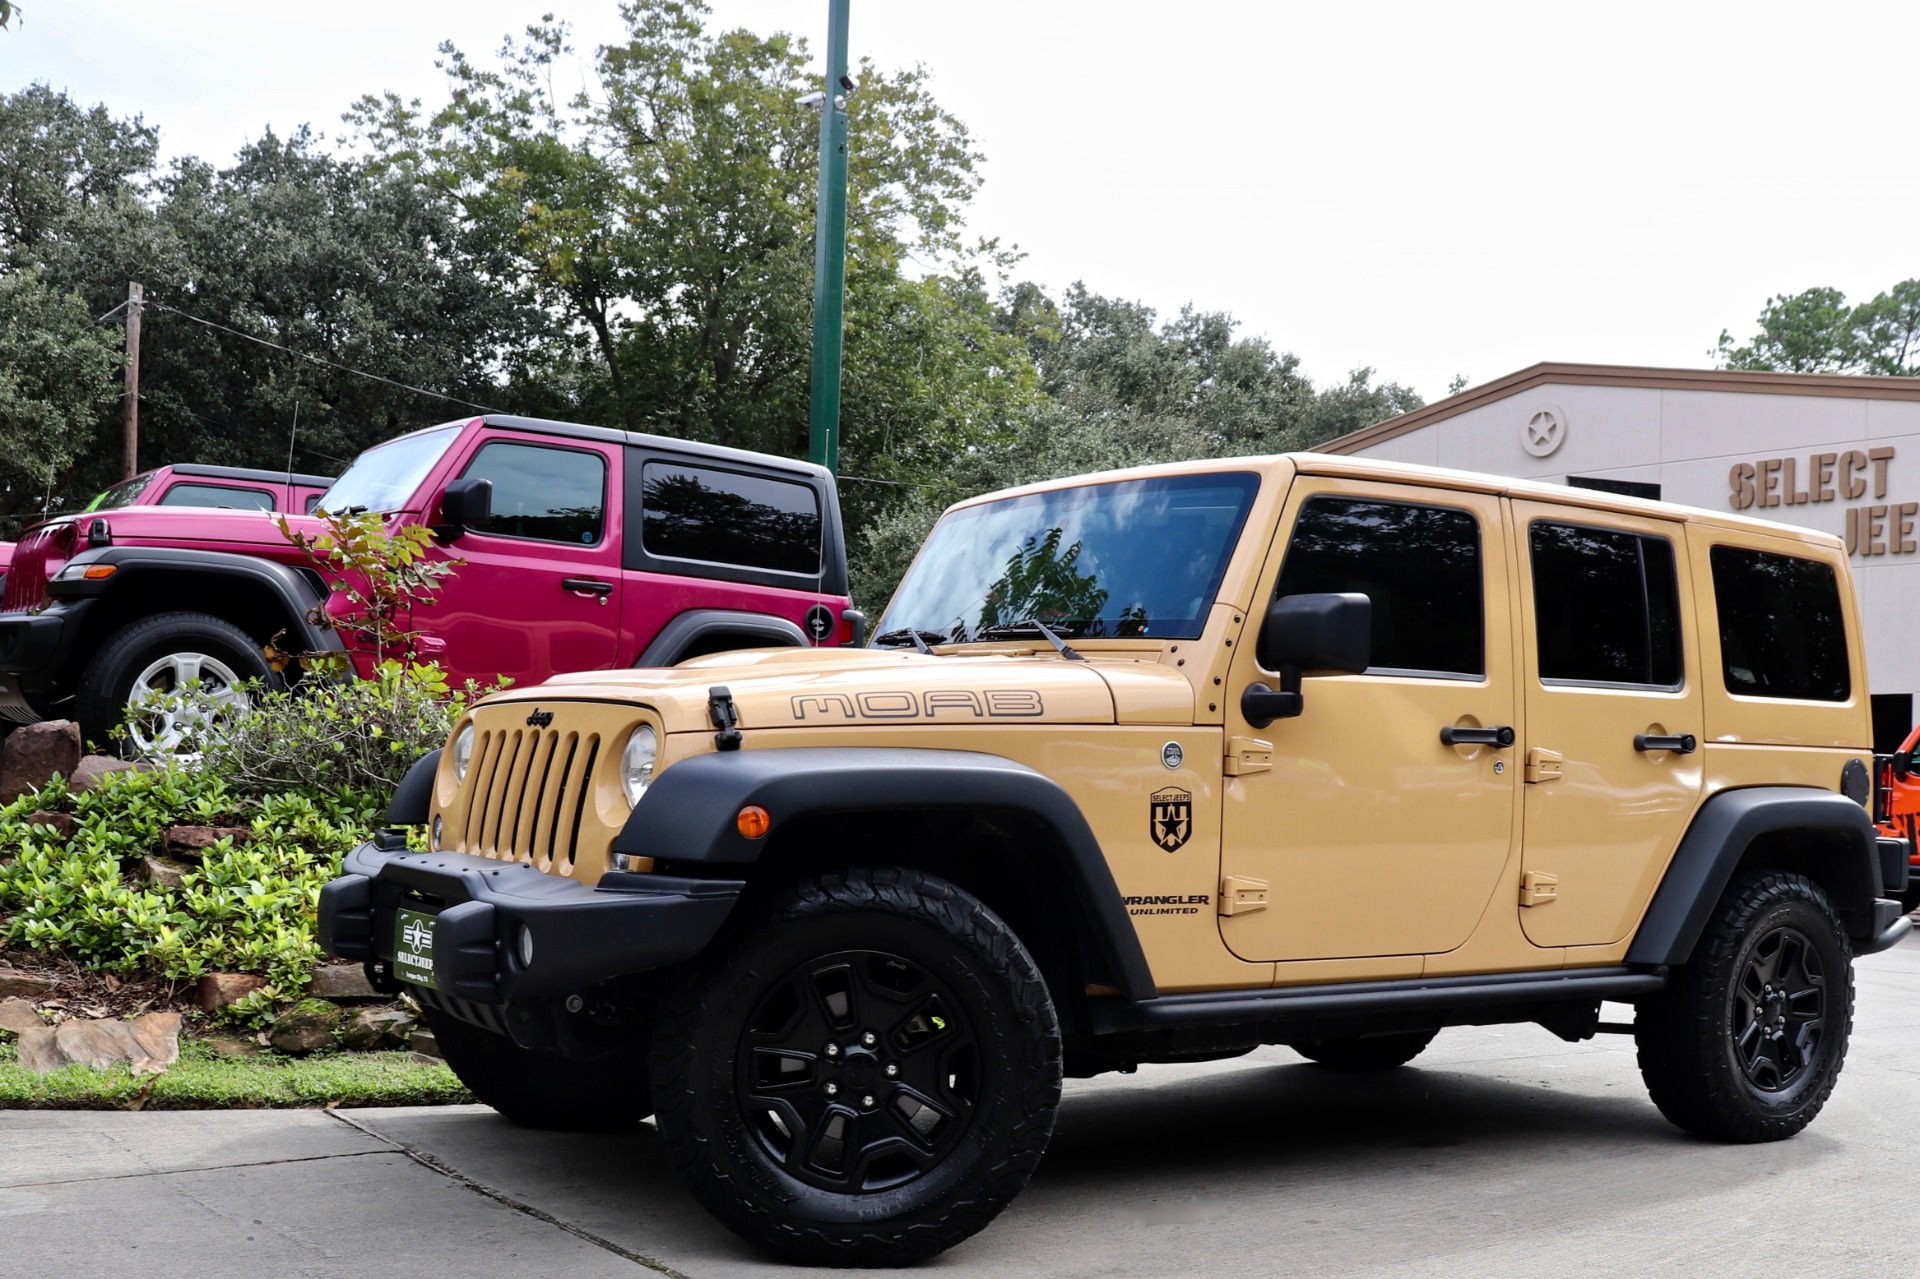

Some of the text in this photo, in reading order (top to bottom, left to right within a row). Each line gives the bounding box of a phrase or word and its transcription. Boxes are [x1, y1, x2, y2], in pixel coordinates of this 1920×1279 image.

[1729, 446, 1894, 509] SELECT
[526, 707, 554, 729] Jeep
[790, 690, 1044, 719] MOAB
